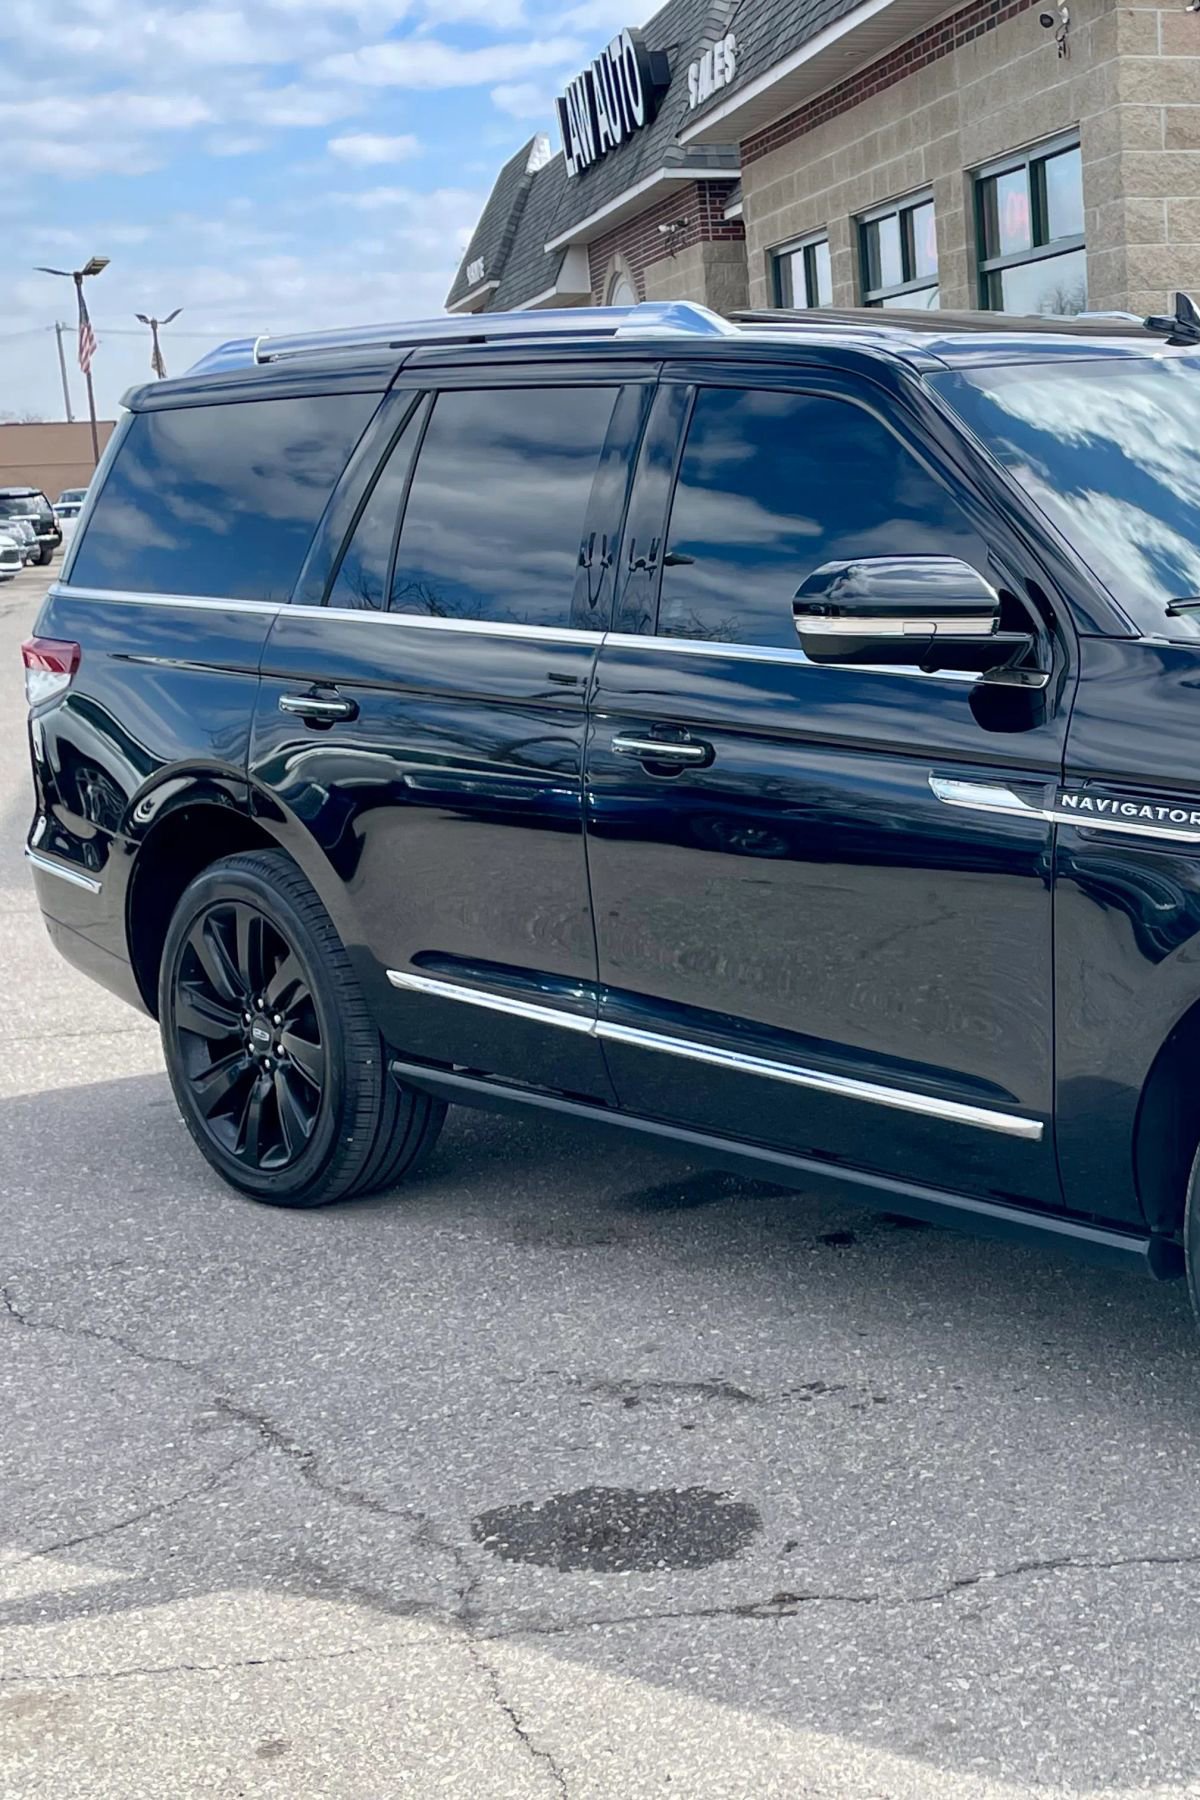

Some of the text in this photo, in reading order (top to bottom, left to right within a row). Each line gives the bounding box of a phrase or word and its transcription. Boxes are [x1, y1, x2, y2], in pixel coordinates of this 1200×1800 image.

[556, 27, 644, 178] LAW AUTO
[688, 33, 737, 110] SALES
